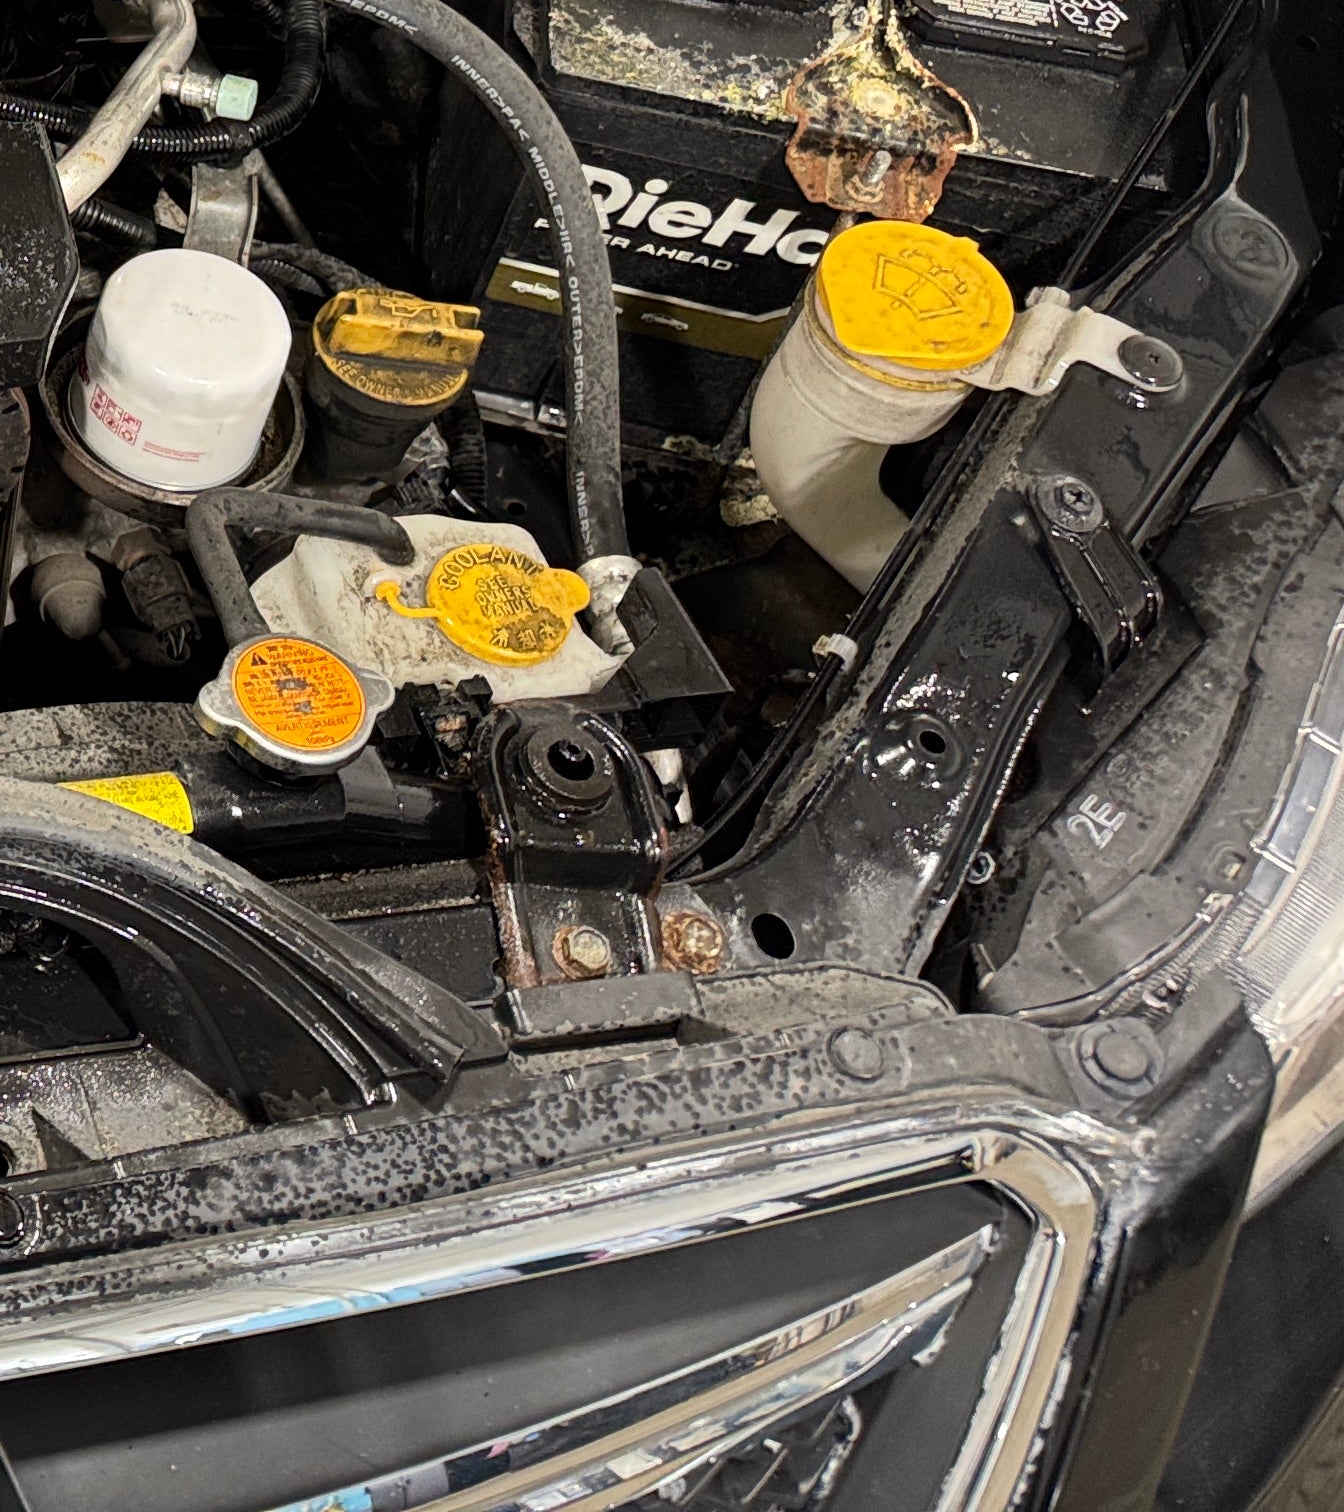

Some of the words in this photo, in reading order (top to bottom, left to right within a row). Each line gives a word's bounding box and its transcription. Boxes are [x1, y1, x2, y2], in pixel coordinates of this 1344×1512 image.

[581, 163, 830, 267] DieHa
[635, 242, 734, 272] AHEAD
[332, 359, 358, 380] SEE
[438, 545, 545, 592] COOLANT
[475, 583, 532, 607] OWNERS
[476, 574, 508, 591] SEE
[480, 597, 541, 620] MANUAL
[1067, 794, 1127, 850] 2E
